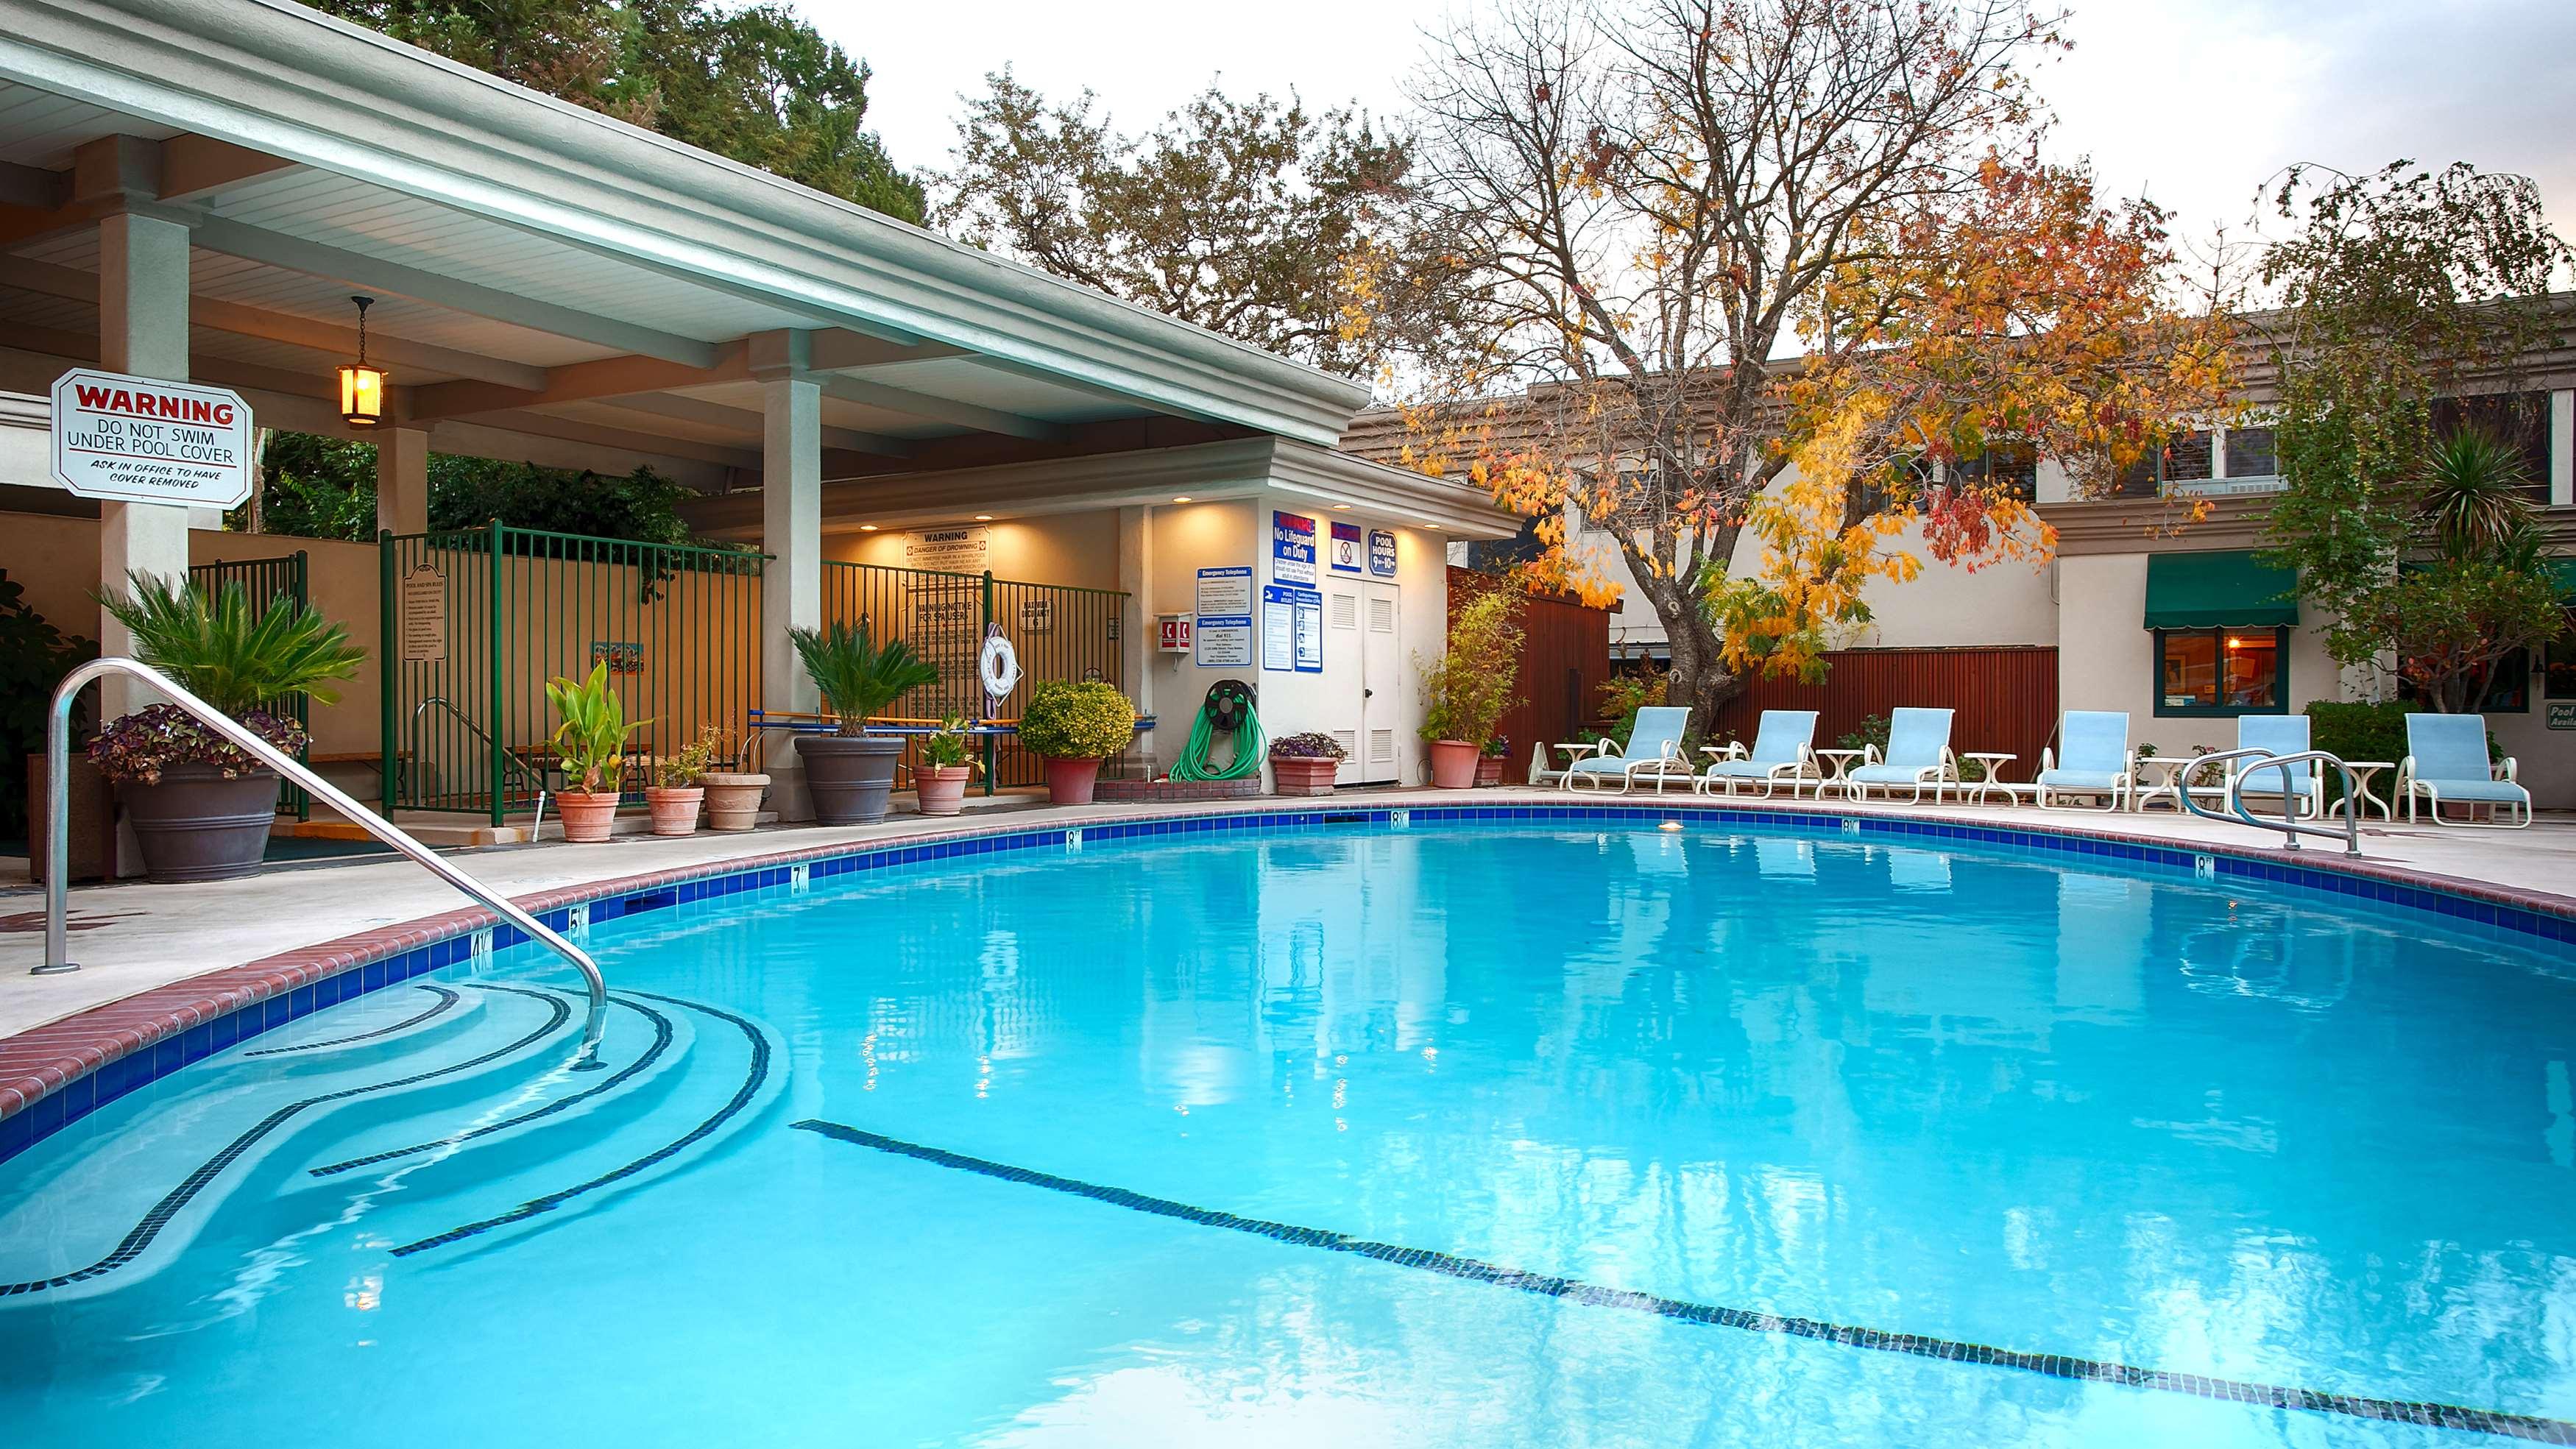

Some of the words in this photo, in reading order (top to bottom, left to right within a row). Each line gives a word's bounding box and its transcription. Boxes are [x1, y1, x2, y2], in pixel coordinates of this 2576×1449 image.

[75, 384, 234, 425] WARNING
[98, 419, 122, 434] DO
[130, 422, 164, 439] NOT
[171, 428, 215, 445] SWIM
[68, 431, 125, 451] UNDER
[132, 439, 174, 456] POOL
[180, 444, 234, 463] COVER
[91, 460, 117, 470] ASK
[118, 462, 132, 471] IN
[134, 464, 173, 475] OFFICE
[177, 468, 191, 477] TO
[194, 470, 222, 480] HAVE
[110, 473, 146, 484] COVER
[149, 477, 199, 489] REMOVED
[924, 531, 968, 542] WARNING
[1274, 527, 1284, 541] No
[1284, 528, 1314, 548] Lifeguard
[1376, 536, 1393, 548] POOL
[946, 543, 977, 551] DROWNING
[1283, 545, 1292, 556] on
[1292, 545, 1308, 563] Duty
[1373, 546, 1395, 557] HOURS
[2550, 706, 2575, 716] Pool
[793, 867, 800, 882] 7
